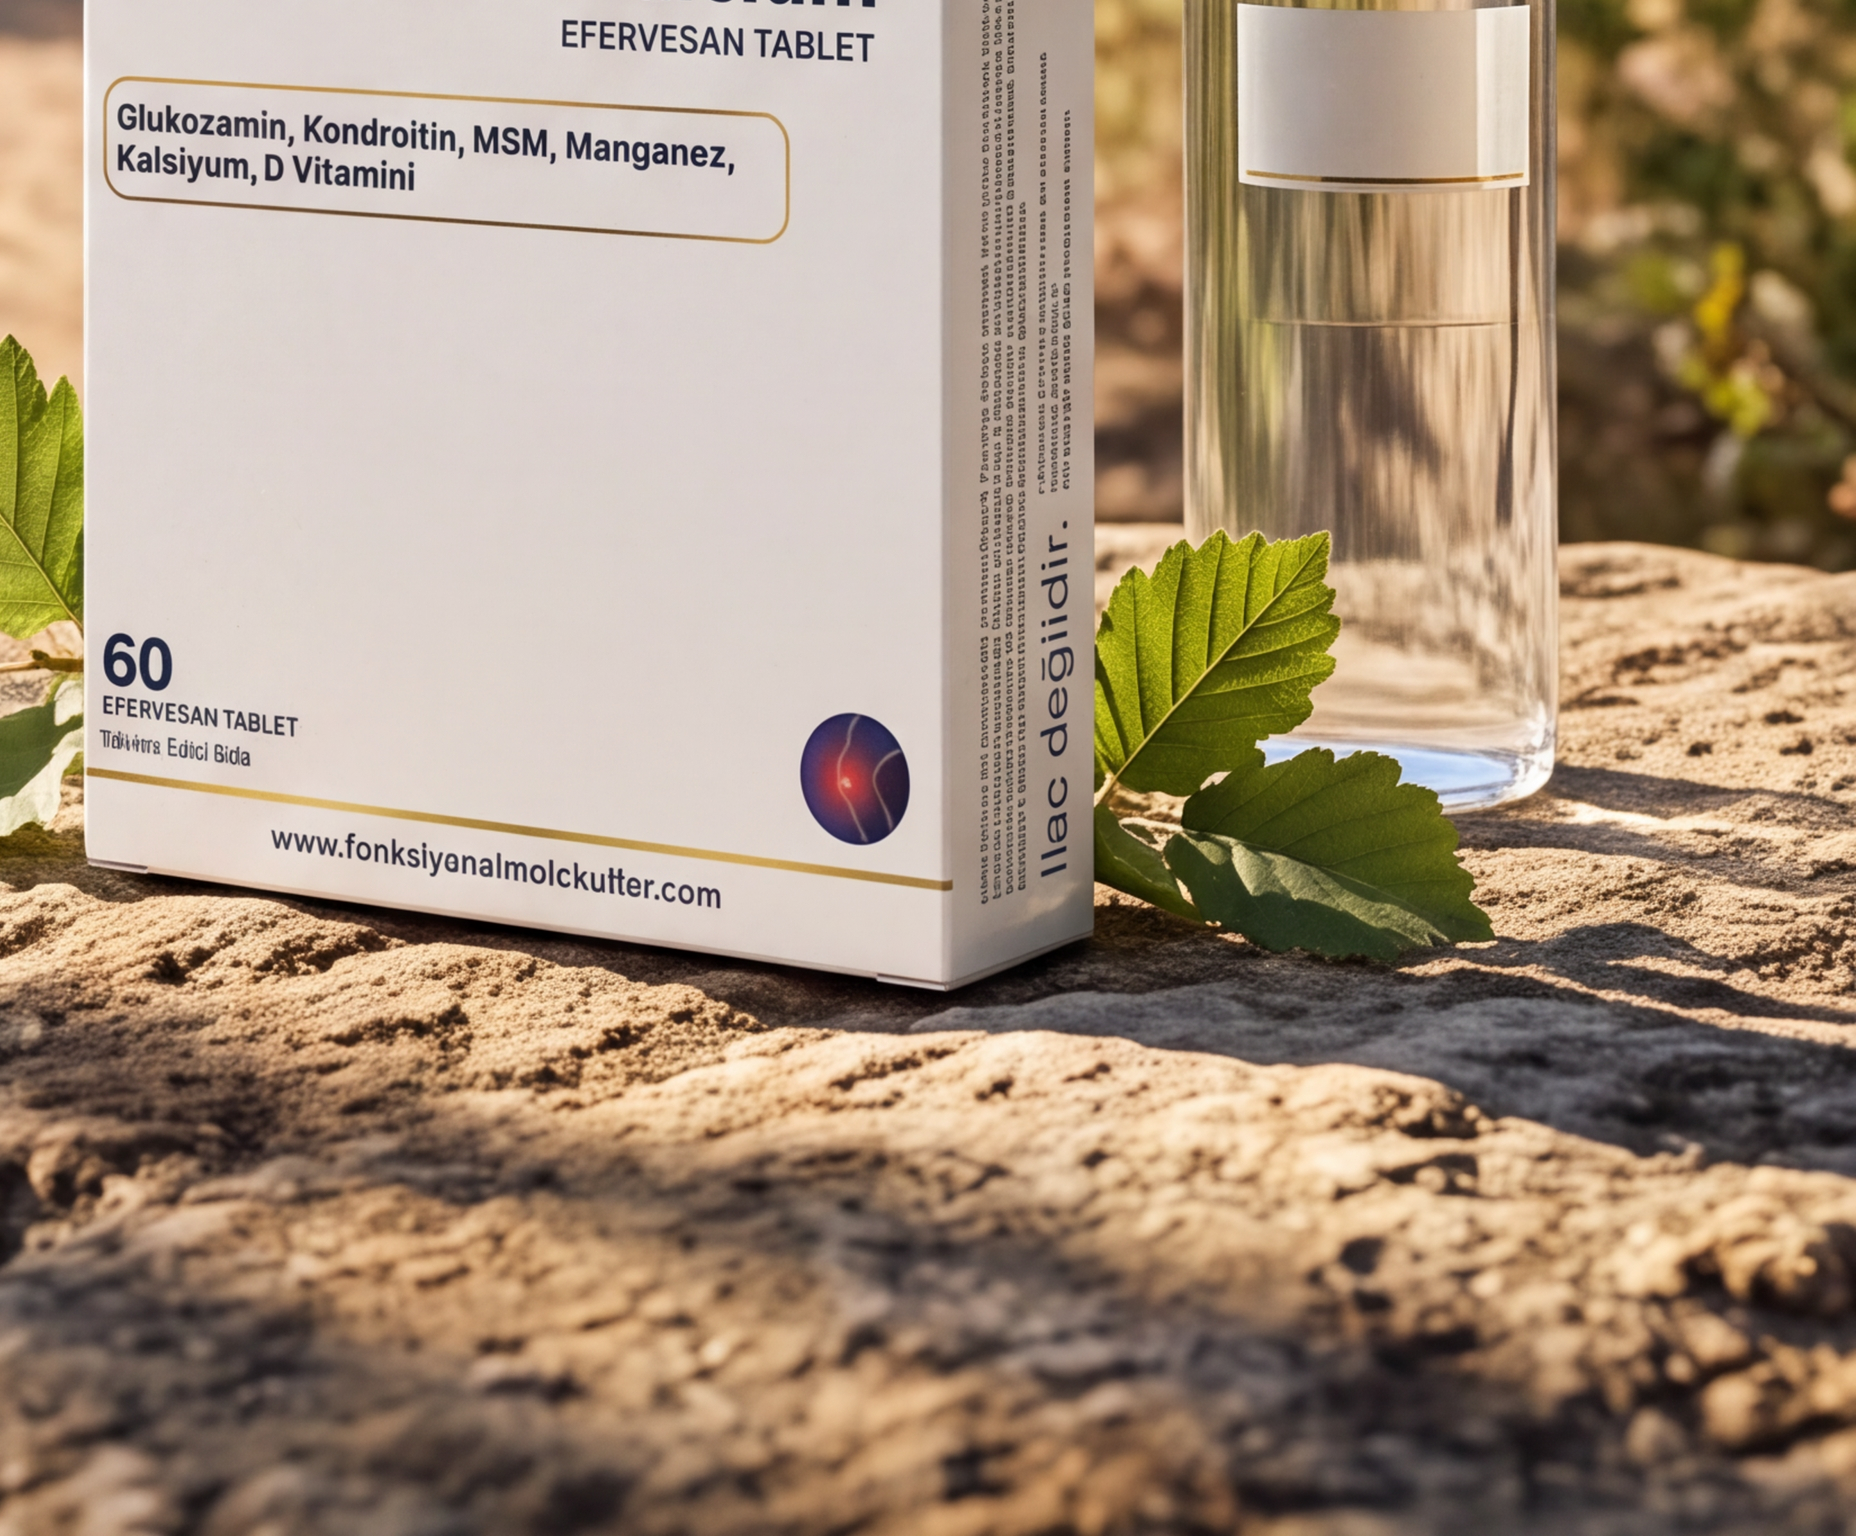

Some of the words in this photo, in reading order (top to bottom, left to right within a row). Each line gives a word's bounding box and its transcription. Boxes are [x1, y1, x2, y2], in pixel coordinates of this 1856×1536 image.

[561, 19, 744, 57] EFERVESAN
[753, 28, 875, 63] TABLET
[117, 103, 295, 148] Glukozamin,
[303, 114, 465, 160] Kondroitin,
[473, 124, 557, 165] MSM,
[566, 130, 735, 176] Manganez,
[117, 143, 258, 187] Kalsiyum,
[264, 153, 285, 182] D
[291, 154, 415, 191] Vitamini
[102, 632, 173, 692] 60
[102, 694, 218, 728] EFERVESAN
[222, 709, 299, 738] TABLET
